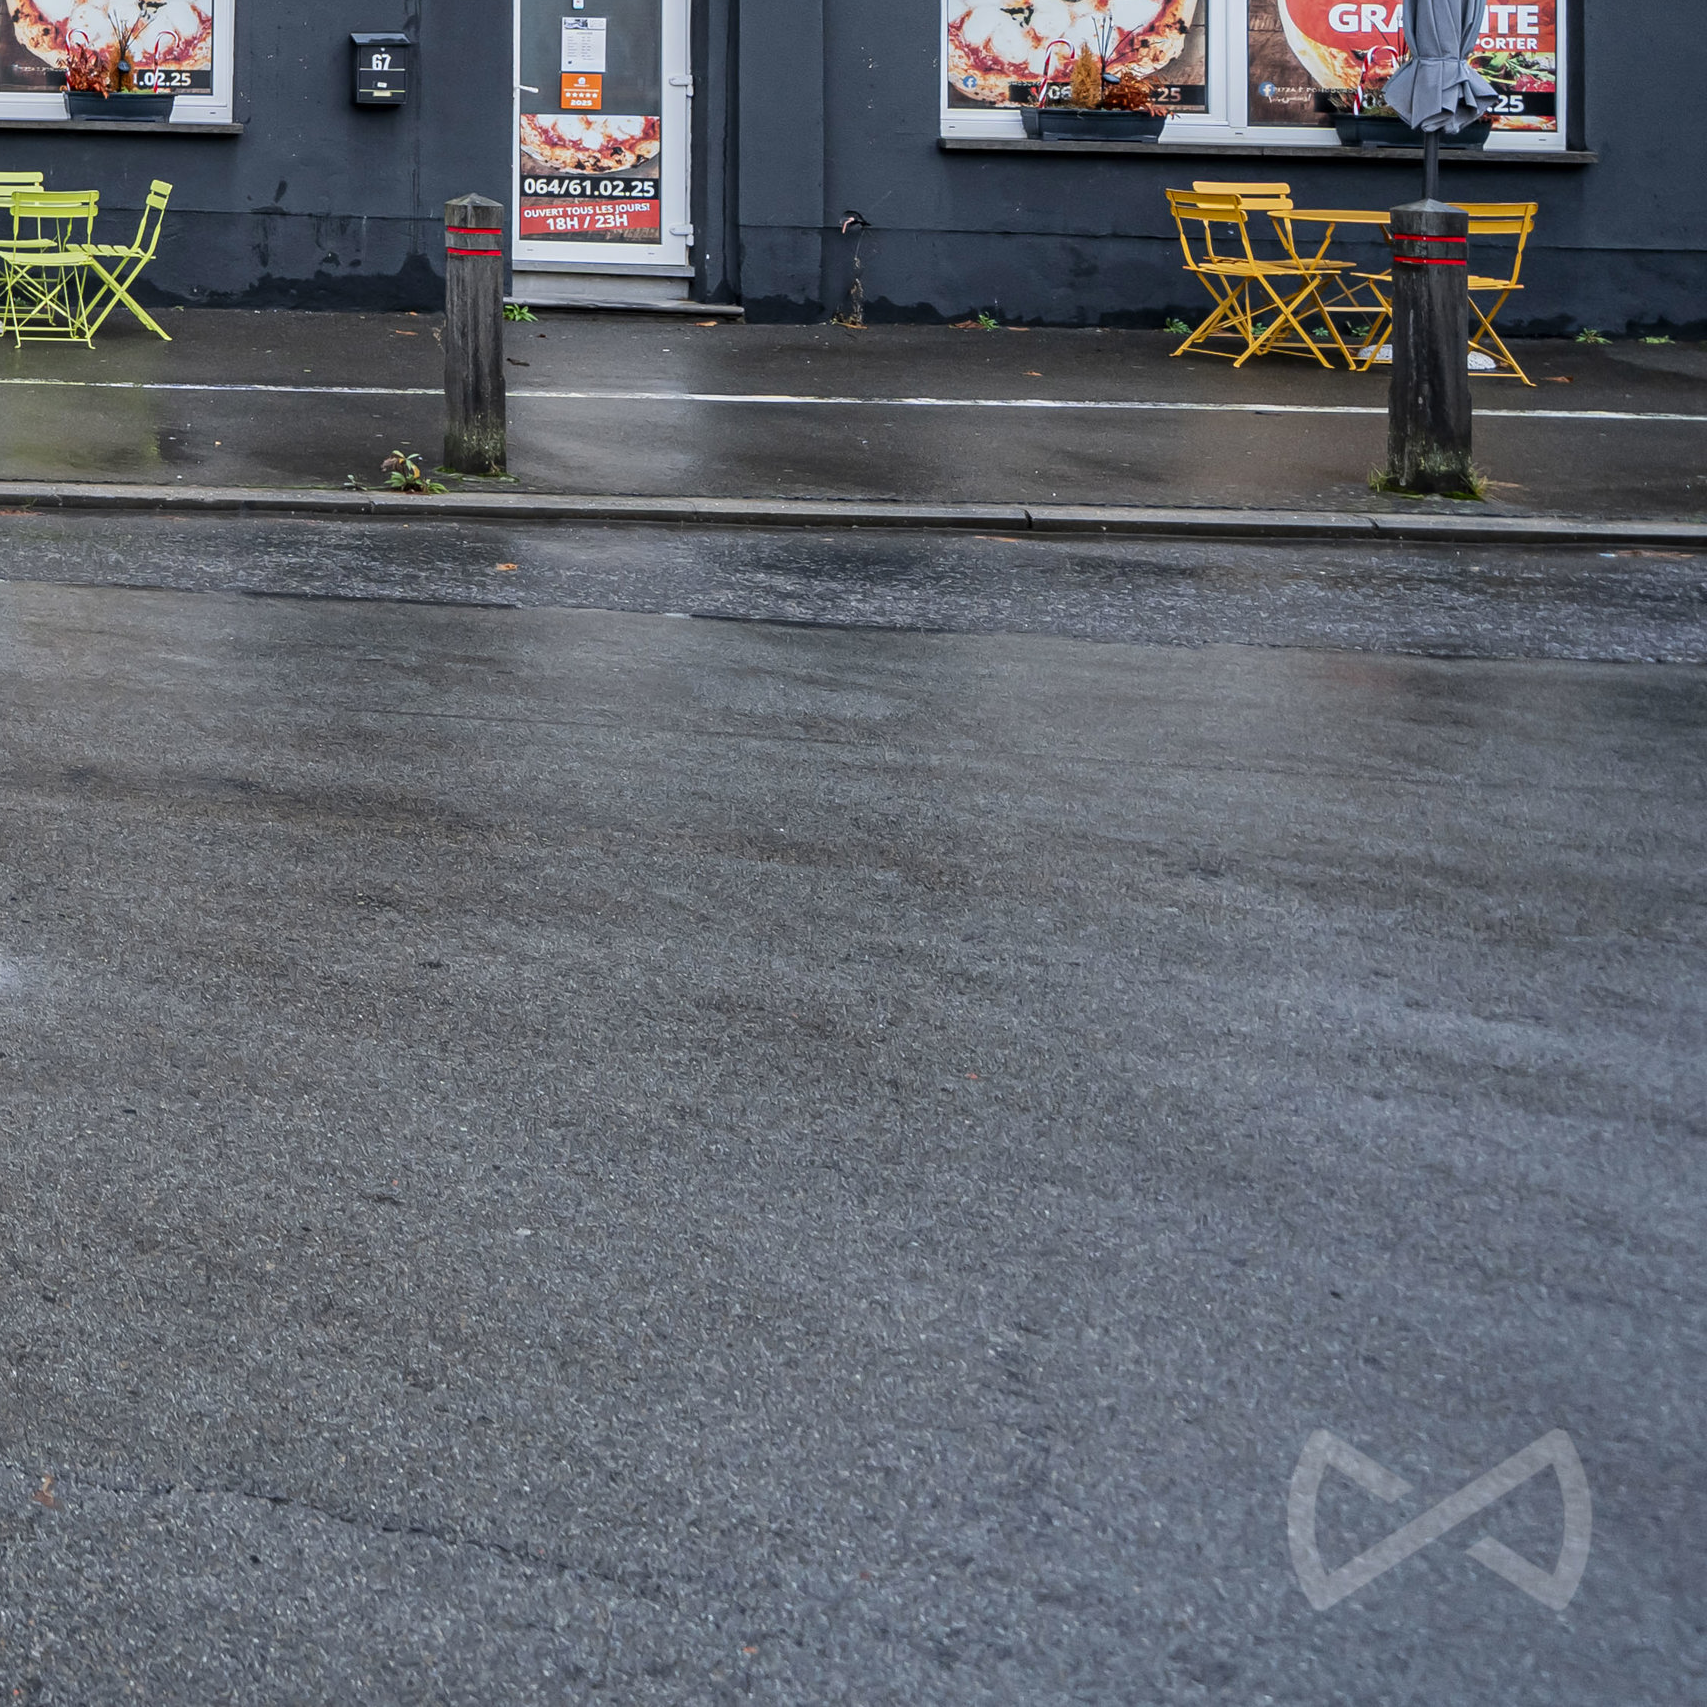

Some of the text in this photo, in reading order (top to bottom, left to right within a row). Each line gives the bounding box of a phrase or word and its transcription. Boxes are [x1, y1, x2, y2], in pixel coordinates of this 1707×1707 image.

[1328, 3, 1539, 34] GRAITE
[1476, 36, 1538, 50] ORTER
[372, 53, 392, 70] 67
[523, 178, 656, 197] 064/61.02.25
[523, 203, 650, 218] OUVERT TOUS LES JOURS!
[546, 214, 628, 230] 18H / 23H
